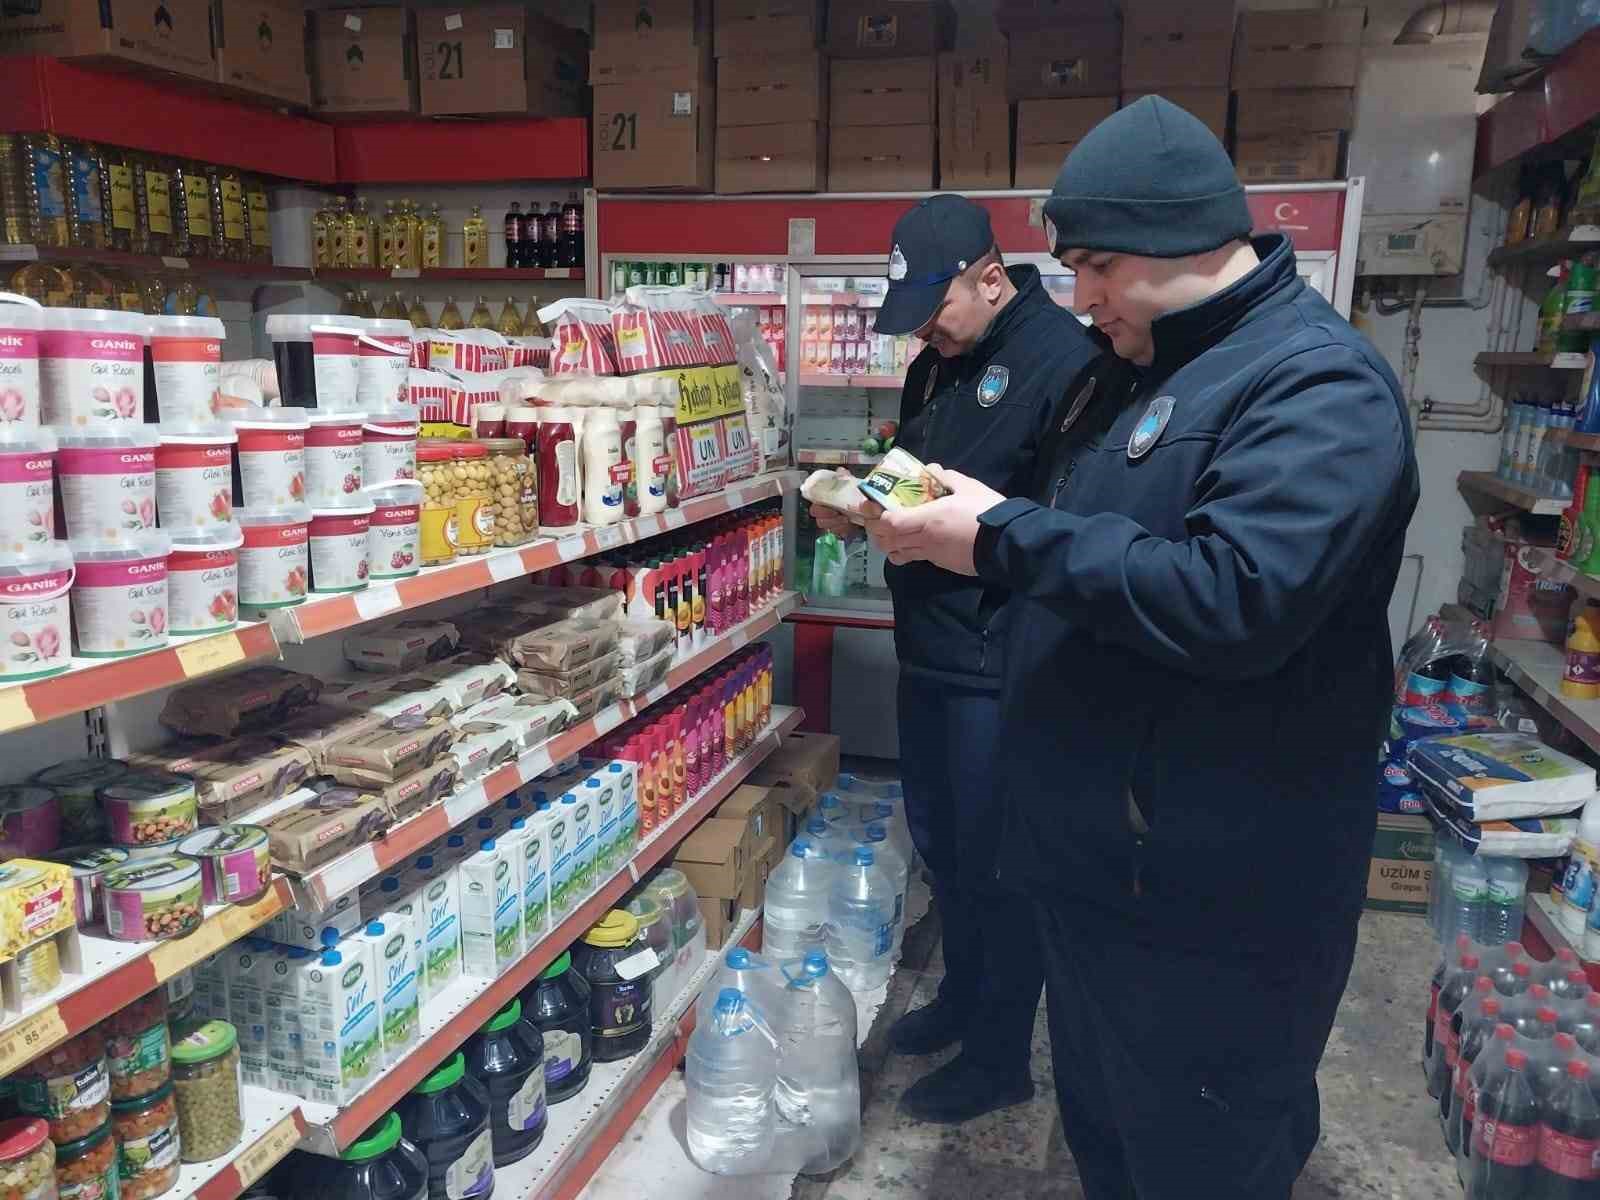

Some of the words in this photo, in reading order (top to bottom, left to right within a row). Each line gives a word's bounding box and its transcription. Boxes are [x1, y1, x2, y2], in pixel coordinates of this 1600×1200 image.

[438, 41, 464, 79] 21
[612, 112, 637, 151] 21
[699, 440, 715, 461] UN
[731, 432, 745, 449] UN
